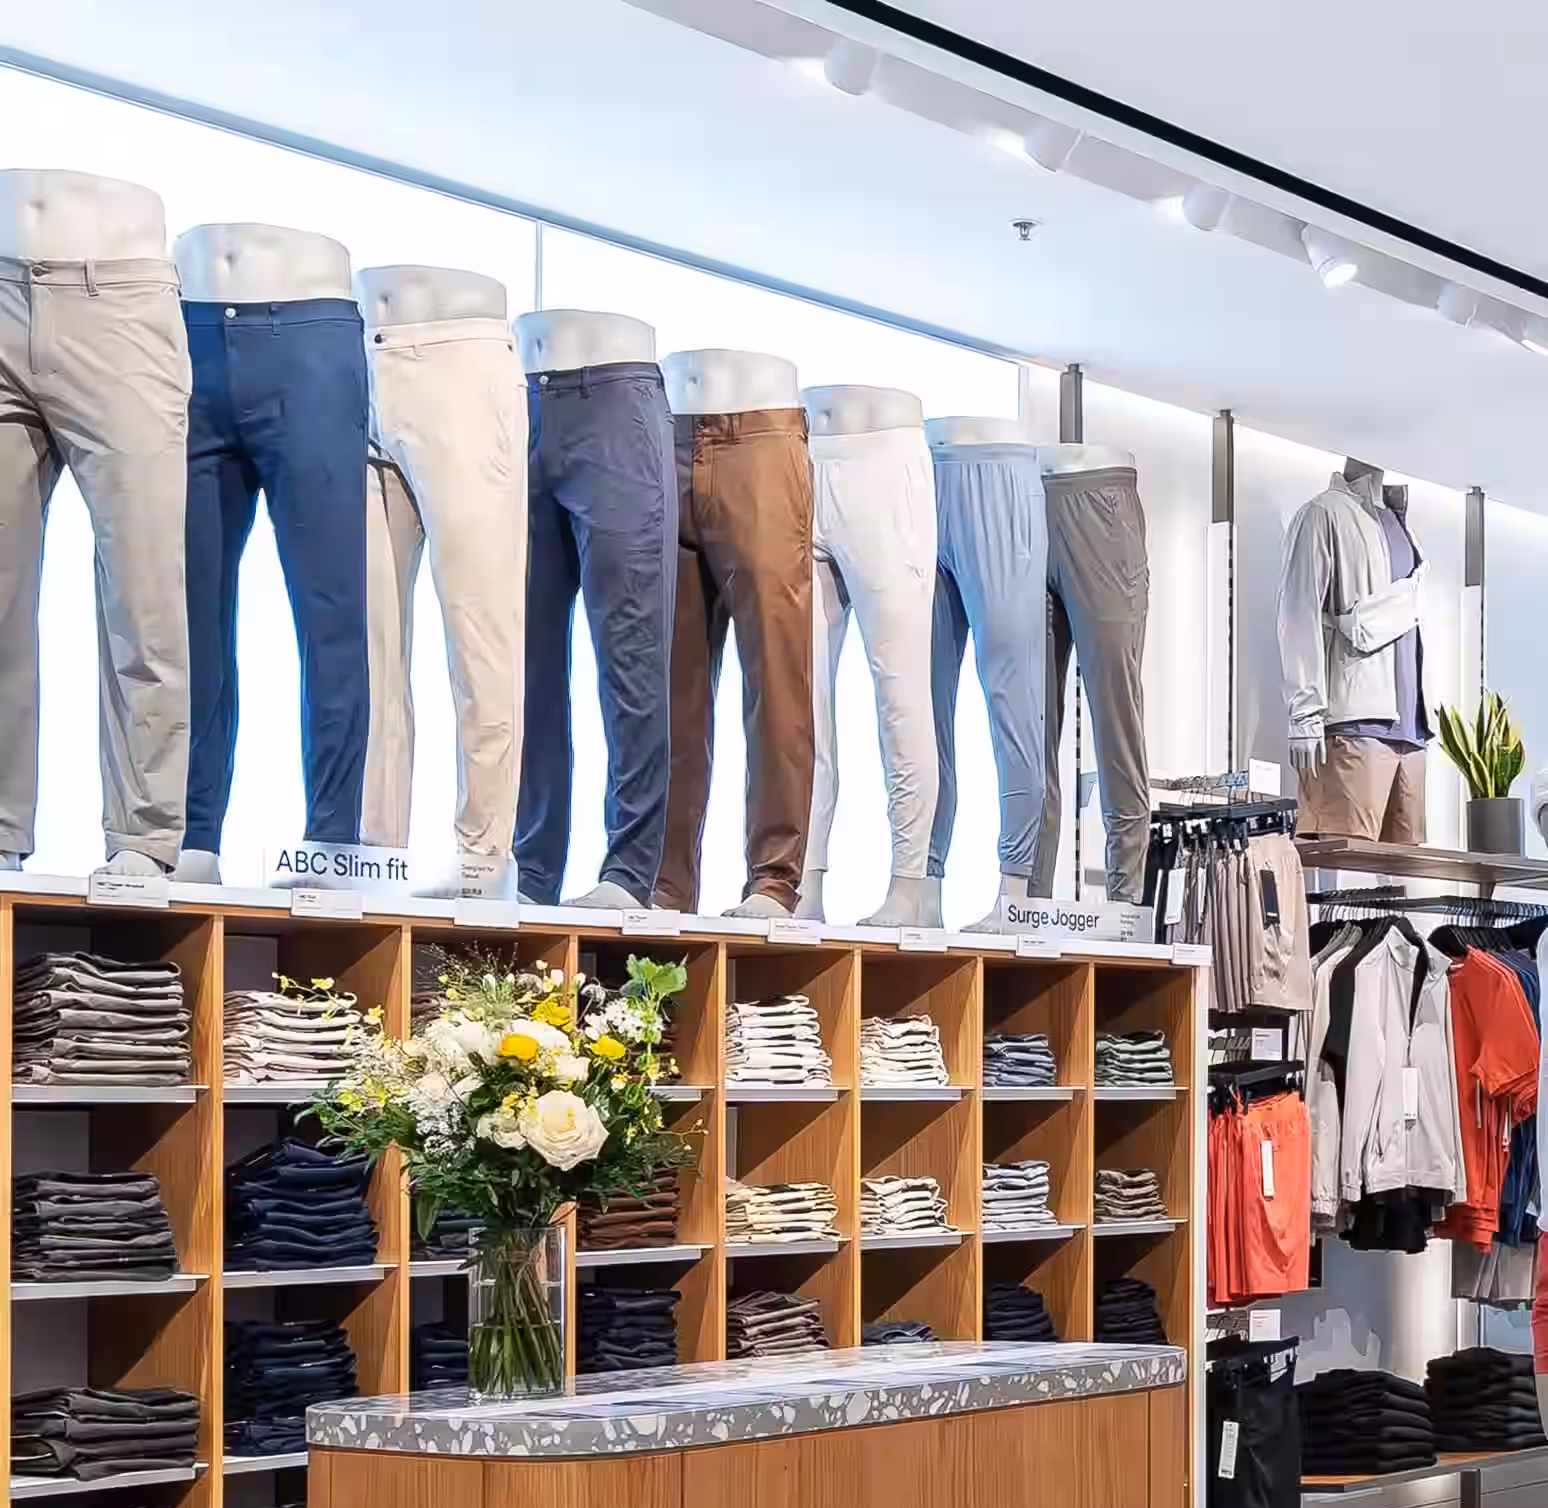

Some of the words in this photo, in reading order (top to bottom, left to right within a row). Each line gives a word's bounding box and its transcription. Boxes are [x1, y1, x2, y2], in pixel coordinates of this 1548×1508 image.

[275, 849, 328, 876] ABC
[333, 853, 381, 879] Slim
[386, 857, 409, 881] fit
[1007, 904, 1049, 929] Surge
[1050, 907, 1100, 932] Jogger
